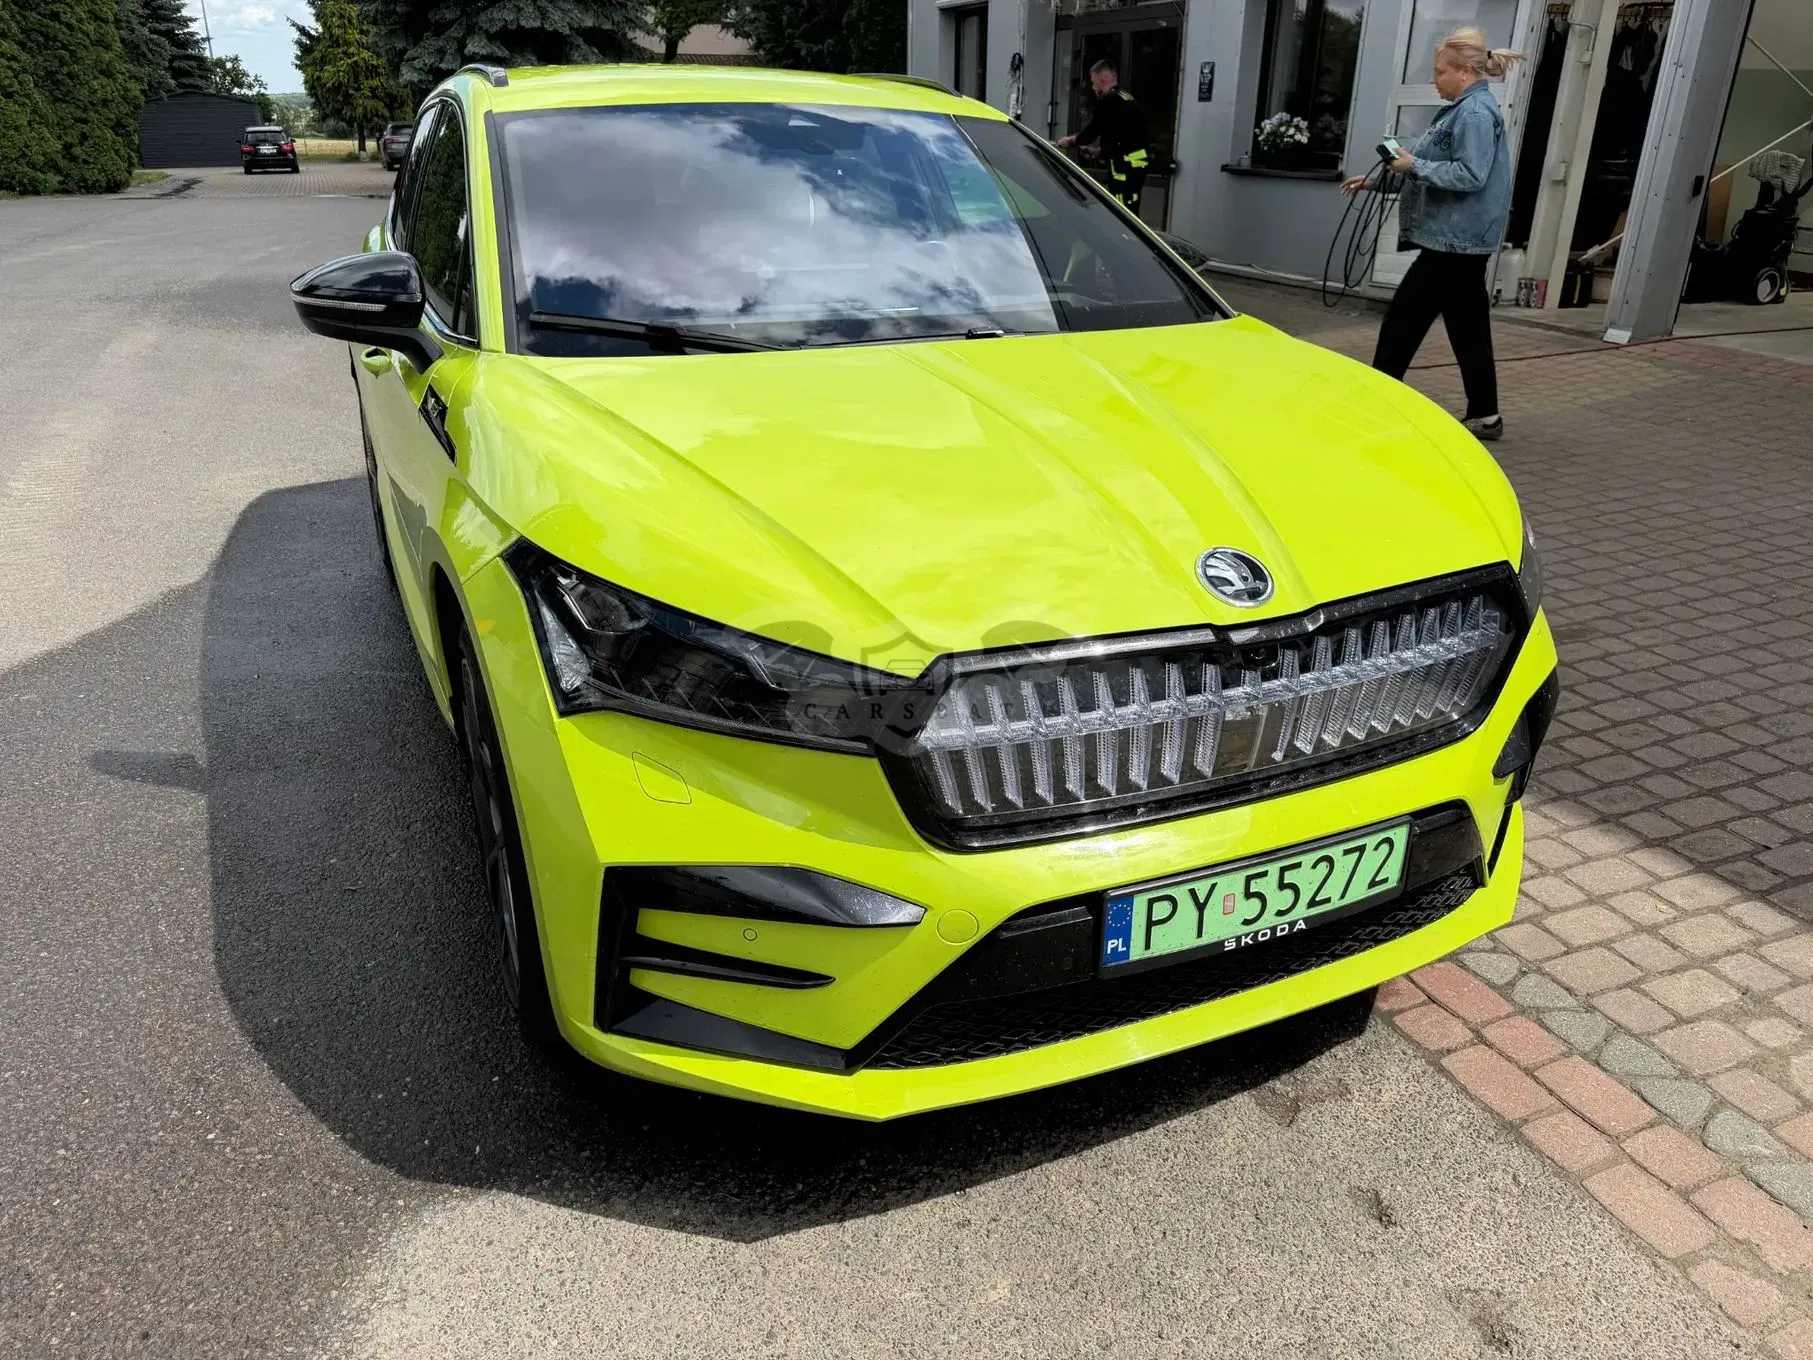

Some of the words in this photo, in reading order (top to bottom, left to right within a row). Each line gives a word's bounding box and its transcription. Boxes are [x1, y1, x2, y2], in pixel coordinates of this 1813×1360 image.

[1144, 882, 1218, 951] PY
[1240, 836, 1396, 927] 55272
[1106, 938, 1128, 955] PL
[1223, 919, 1307, 951] SKODA
